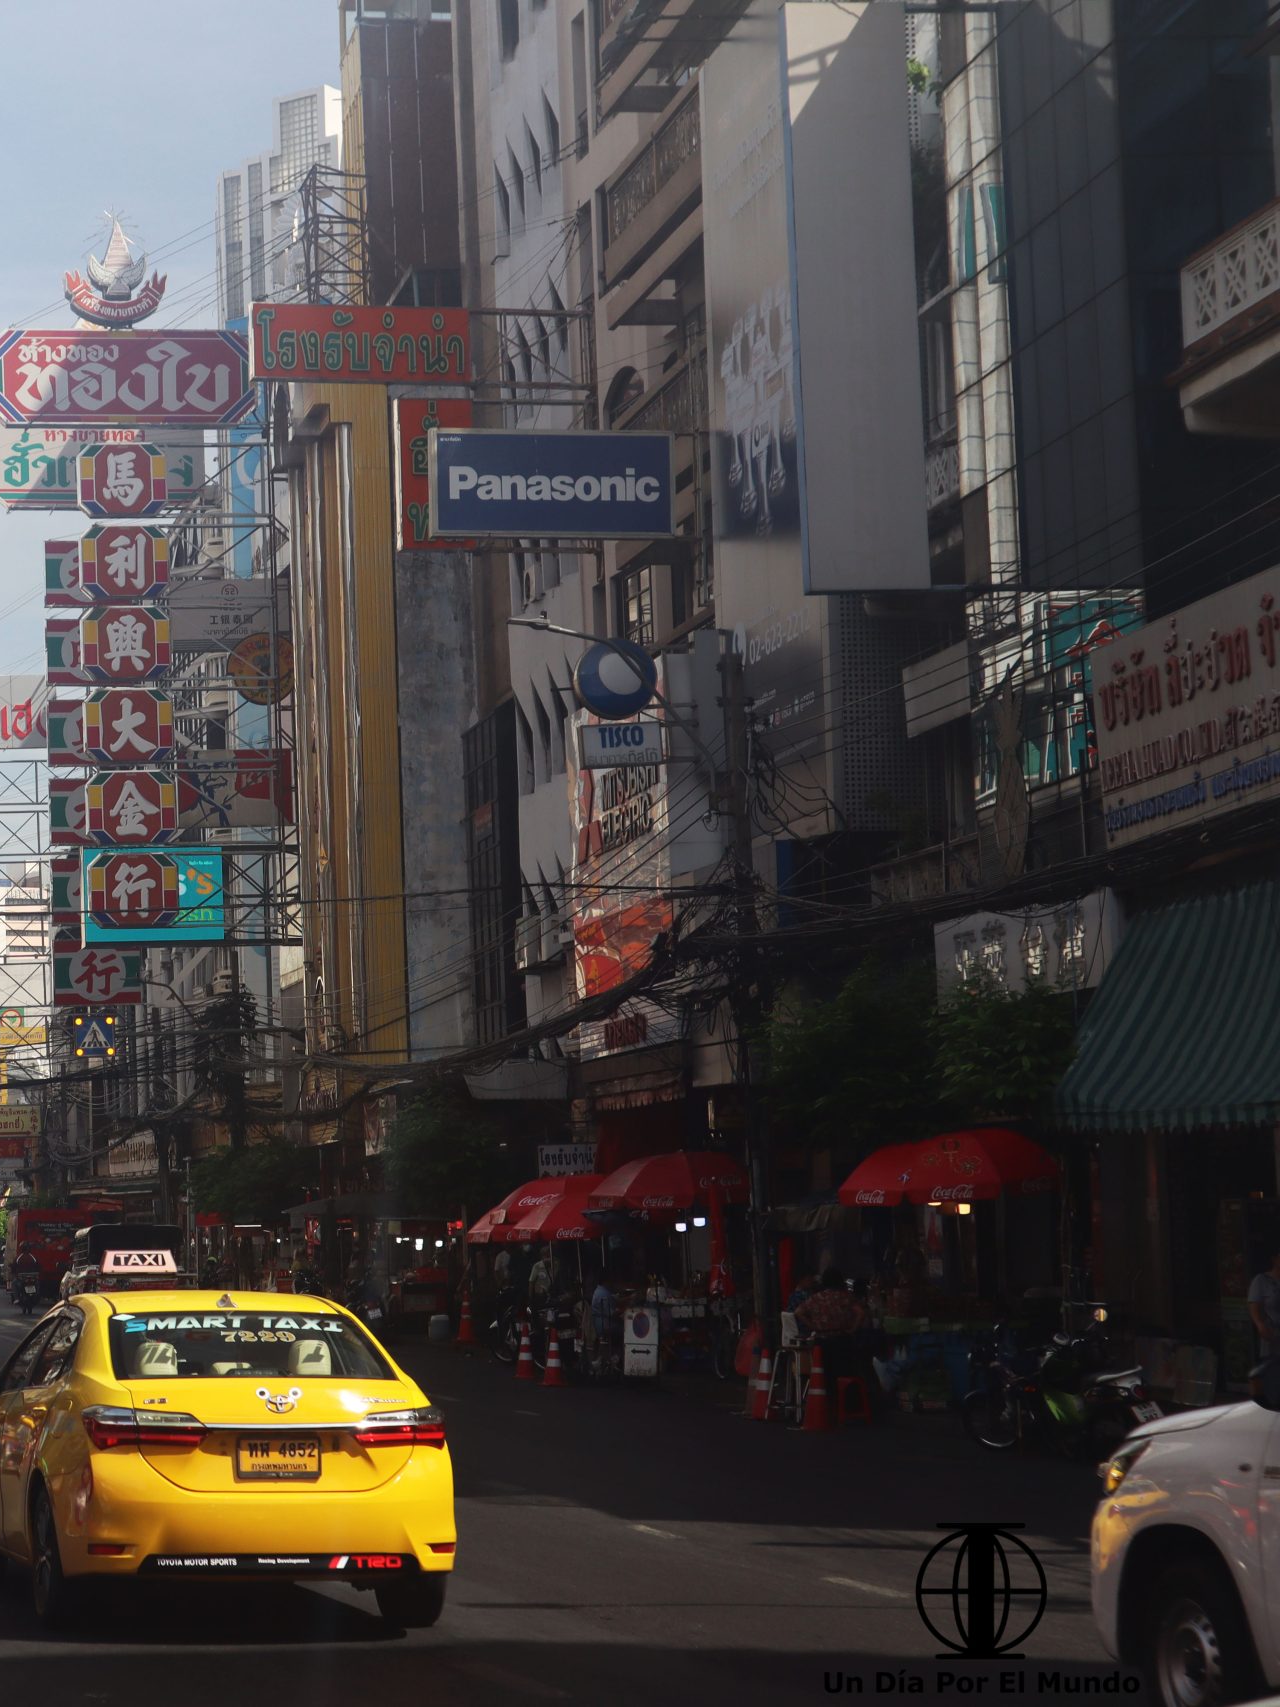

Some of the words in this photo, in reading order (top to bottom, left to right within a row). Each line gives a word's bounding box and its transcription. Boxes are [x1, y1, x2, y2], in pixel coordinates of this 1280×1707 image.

[18, 339, 119, 361] ห้างทอง
[257, 309, 465, 374] โรงรับจำนำ
[16, 341, 230, 412] ทองใบ
[448, 467, 661, 503] Panasonic
[599, 726, 644, 749] TISCO
[586, 748, 659, 766] ธนาคารทิสโก้
[931, 1183, 975, 1200] Coca-Cola
[642, 1195, 676, 1209] Coca-Cola
[556, 1227, 585, 1240] Coca-Cola
[116, 1253, 162, 1266] TAXI
[125, 1314, 247, 1334] SMART
[258, 1315, 343, 1334] TAXI
[221, 1330, 297, 1344] 7229
[278, 1442, 317, 1458] 4852
[157, 1558, 183, 1567] TOYOTA
[184, 1558, 209, 1567] MOTOR
[210, 1558, 238, 1567] SPORTS
[351, 1556, 402, 1568] TRD
